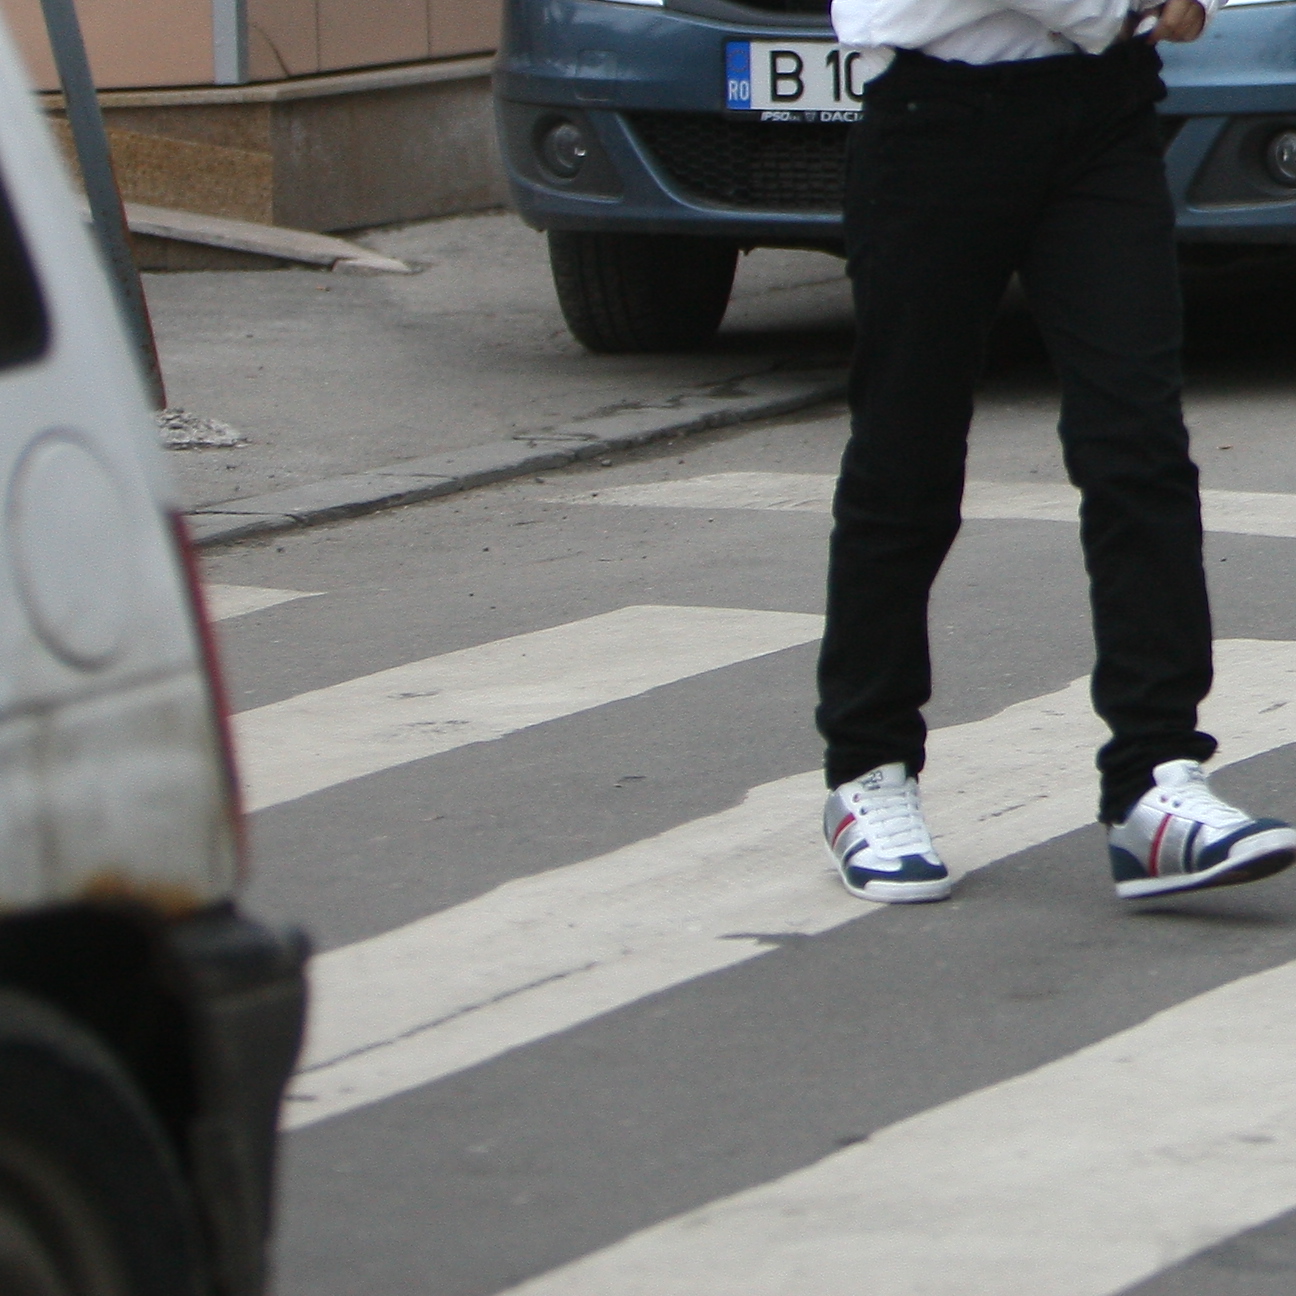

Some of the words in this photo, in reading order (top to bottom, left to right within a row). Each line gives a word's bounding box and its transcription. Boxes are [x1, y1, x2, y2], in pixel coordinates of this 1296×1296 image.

[769, 49, 804, 103] B
[728, 79, 749, 101] RO
[820, 111, 863, 122] DACI
